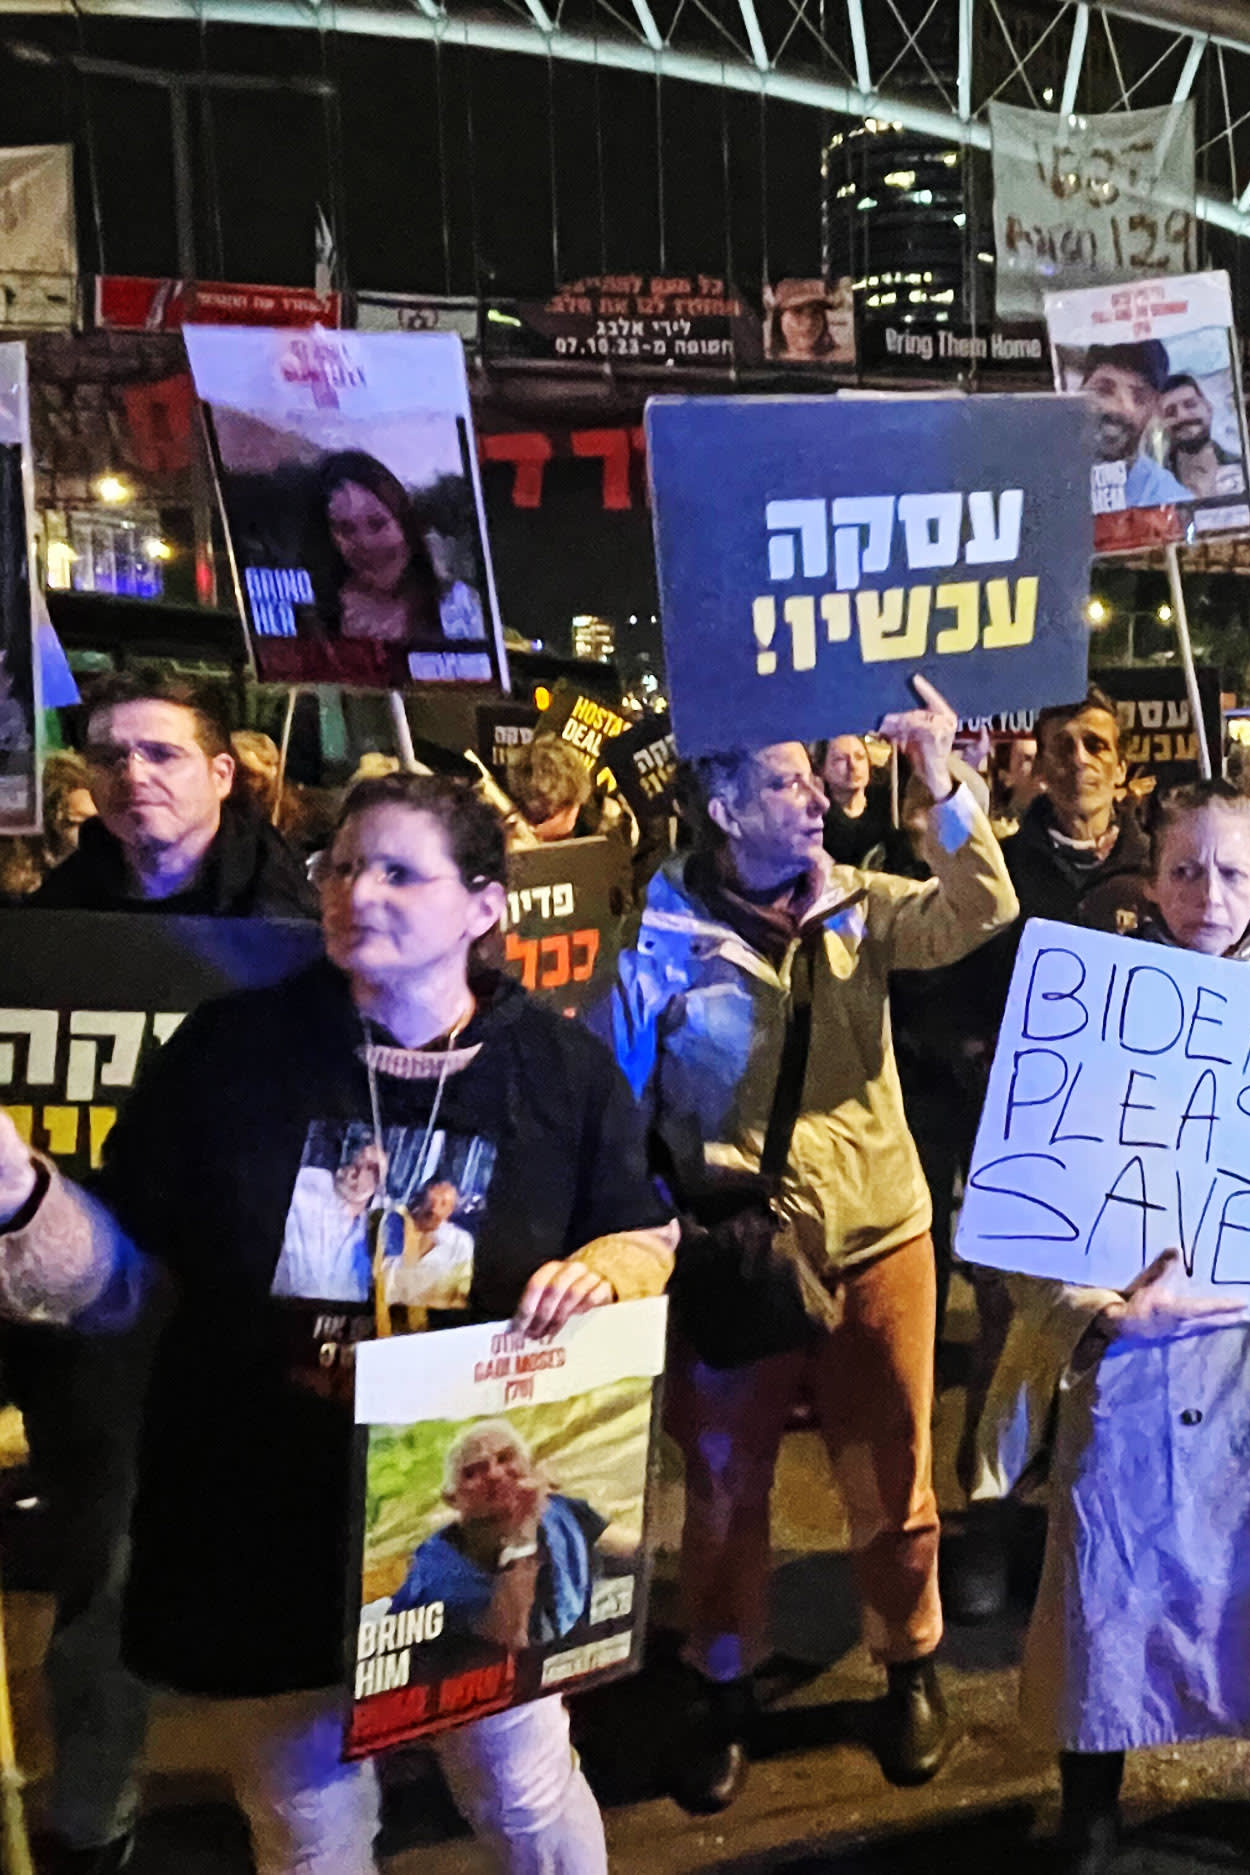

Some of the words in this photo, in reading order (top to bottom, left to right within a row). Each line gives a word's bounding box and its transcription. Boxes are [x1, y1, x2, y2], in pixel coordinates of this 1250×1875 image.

[885, 328, 933, 360] Bring
[937, 330, 986, 358] Them
[992, 334, 1041, 359] Home
[766, 489, 1025, 590] עסקה
[752, 575, 1039, 677] עכשיו!
[496, 726, 536, 746] סקה
[572, 695, 626, 737] HOSTA
[357, 1601, 445, 1661] BRING
[355, 1649, 411, 1699] HIM
